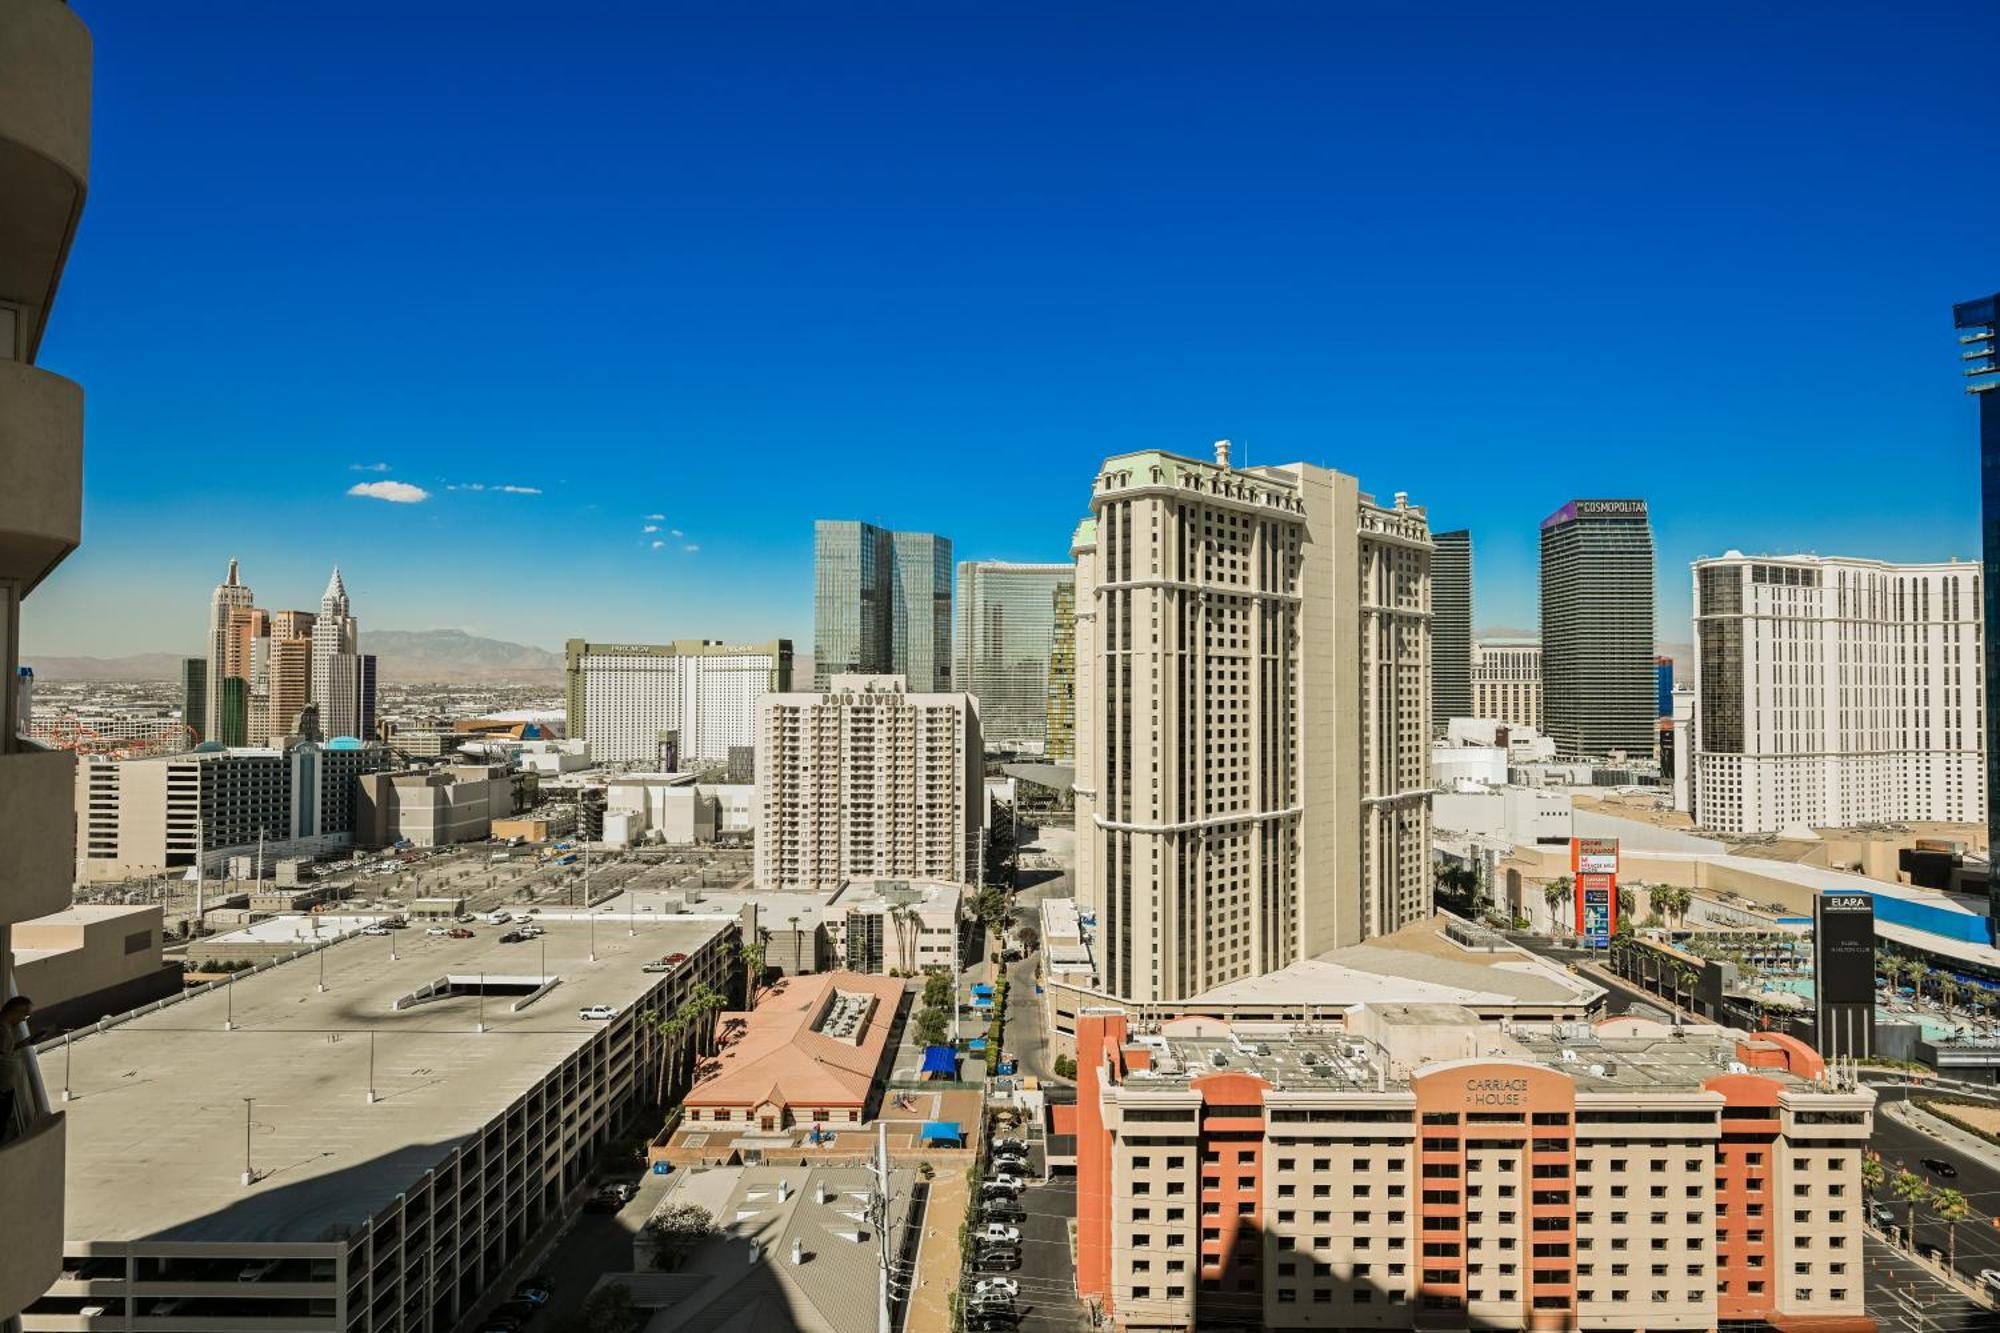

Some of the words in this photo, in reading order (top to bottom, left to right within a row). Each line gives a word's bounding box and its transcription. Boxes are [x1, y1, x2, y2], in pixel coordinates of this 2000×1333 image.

[1584, 502, 1648, 513] COSMOPOLITAN
[822, 694, 854, 706] POLO
[858, 694, 905, 706] TOWERS
[1831, 898, 1865, 907] ELARA
[1466, 1079, 1528, 1092] CARRIAGE
[1475, 1093, 1519, 1106] HOUSE
